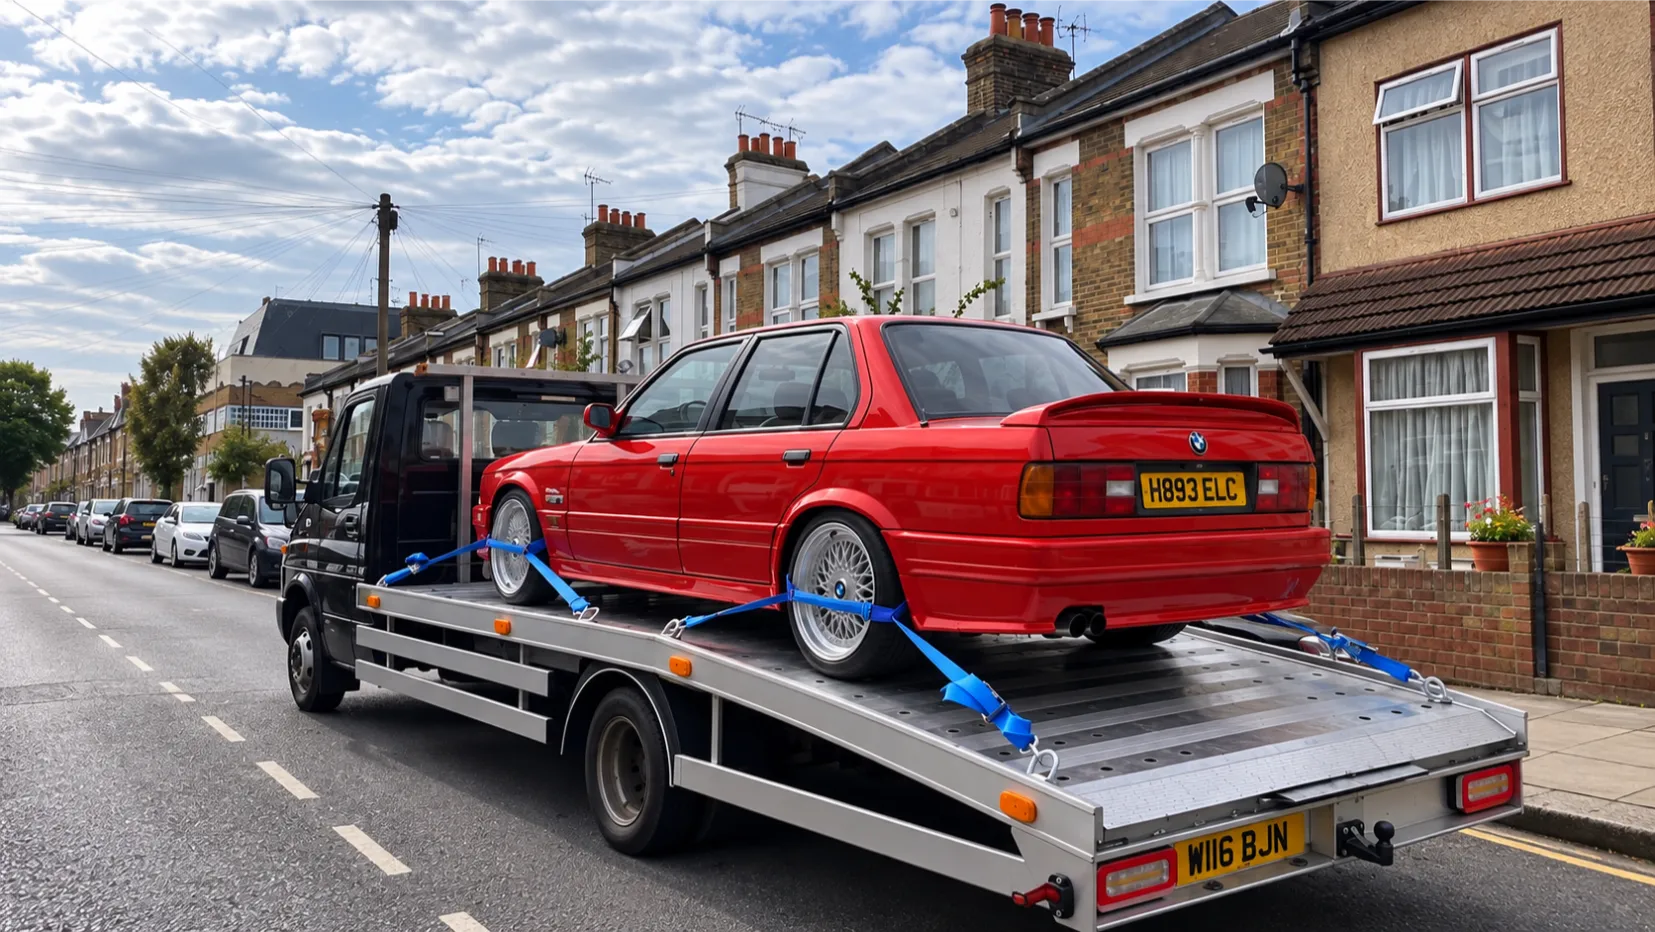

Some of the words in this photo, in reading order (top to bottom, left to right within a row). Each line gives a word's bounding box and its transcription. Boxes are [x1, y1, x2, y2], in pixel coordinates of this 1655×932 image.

[1149, 477, 1198, 502] H893
[1202, 477, 1238, 501] ELC
[1241, 821, 1288, 862] BJN
